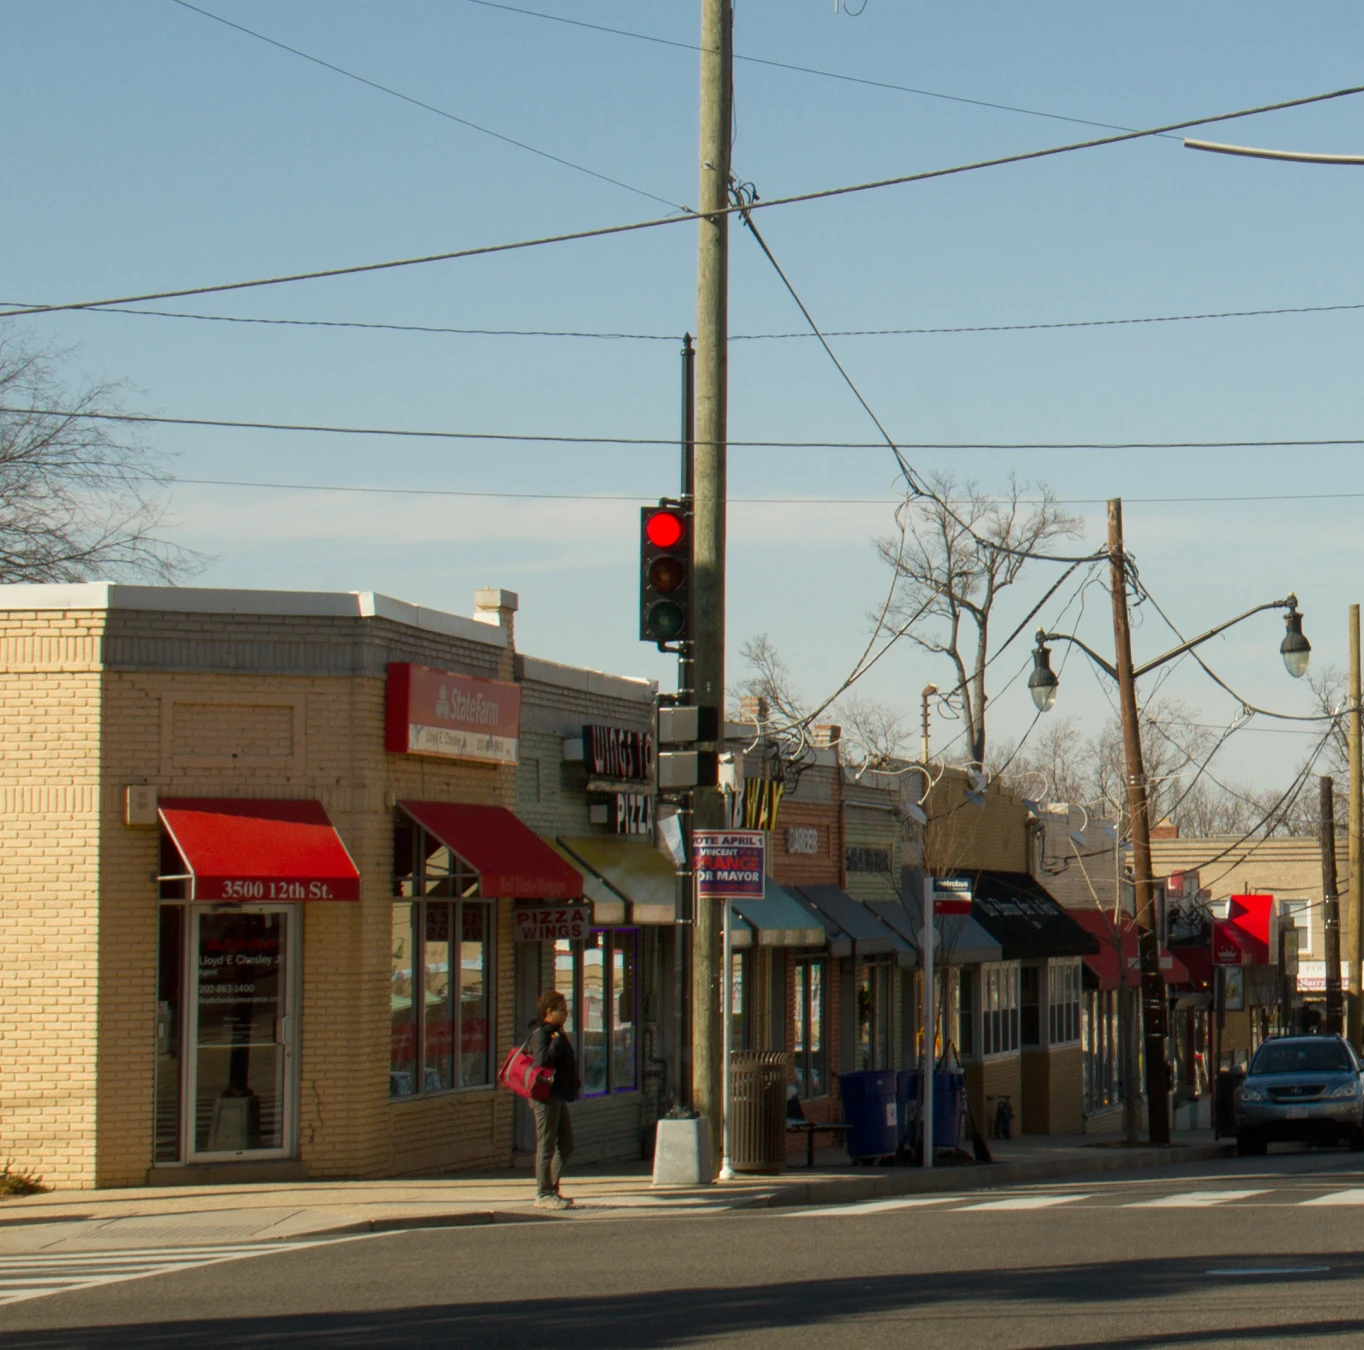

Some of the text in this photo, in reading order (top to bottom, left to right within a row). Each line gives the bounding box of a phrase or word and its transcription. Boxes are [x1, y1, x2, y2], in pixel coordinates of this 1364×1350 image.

[592, 725, 633, 778] WINGS
[721, 836, 755, 845] APRIL
[758, 837, 763, 846] 1
[700, 847, 738, 857] VINCENT
[692, 855, 760, 871] ORANGE
[698, 871, 760, 882] OR MAYOR
[222, 880, 333, 899] 3500 12th St.
[516, 908, 586, 926] PIZZA
[520, 923, 583, 940] WINGS
[199, 954, 224, 966] Lloyd
[226, 954, 234, 965] E
[235, 954, 273, 966] Chesley
